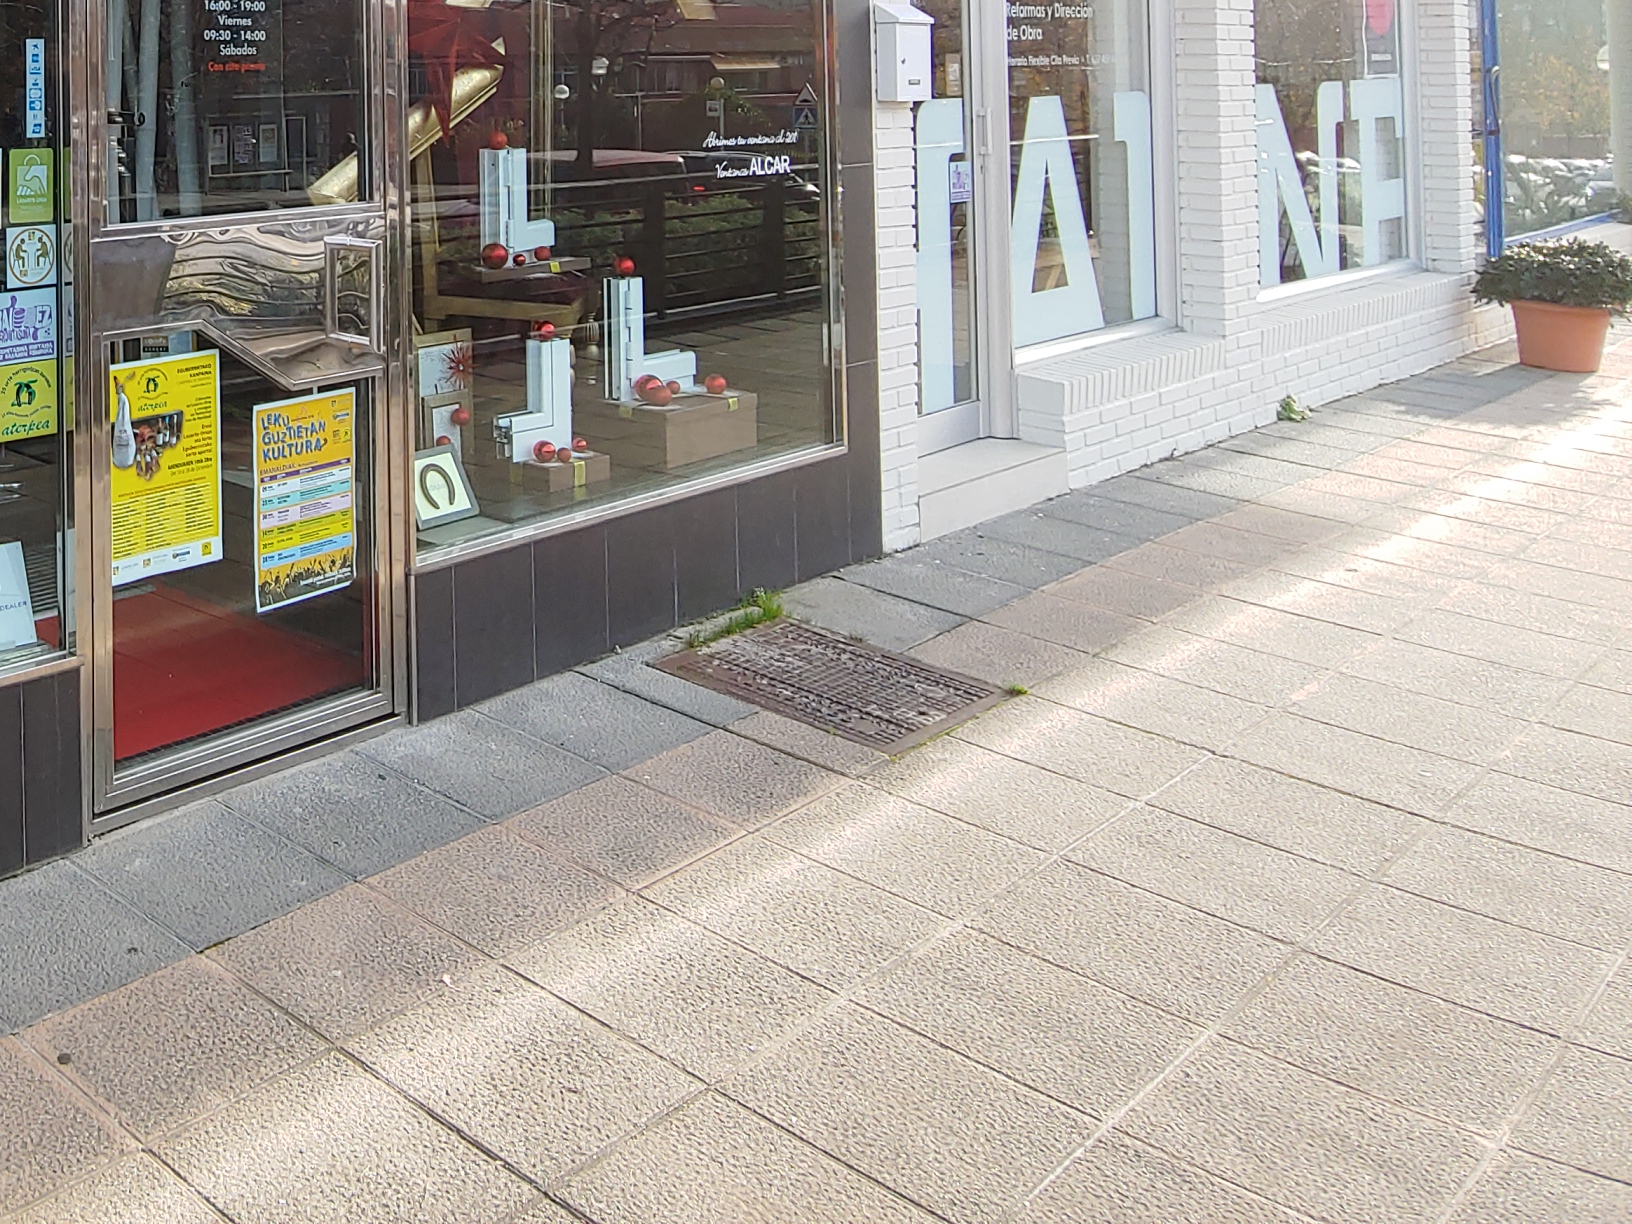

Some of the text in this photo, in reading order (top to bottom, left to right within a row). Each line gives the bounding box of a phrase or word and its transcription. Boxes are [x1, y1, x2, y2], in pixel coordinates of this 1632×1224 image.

[204, 0, 230, 11] 16:00
[240, 1, 265, 11] 19:00
[1006, 2, 1094, 20] Reformas y Dirección
[218, 15, 252, 26] Viernes
[203, 30, 231, 40] 09:30
[240, 31, 266, 41] 14:00
[1007, 25, 1043, 40] de Obra
[219, 43, 257, 56] Sábados
[749, 156, 790, 175] ALCAR
[1, 419, 50, 436] aterpea
[261, 413, 290, 430] LEKU
[261, 420, 326, 446] GUZTIETAN
[262, 437, 324, 463] KULTURA
[0, 601, 27, 612] DEALER
